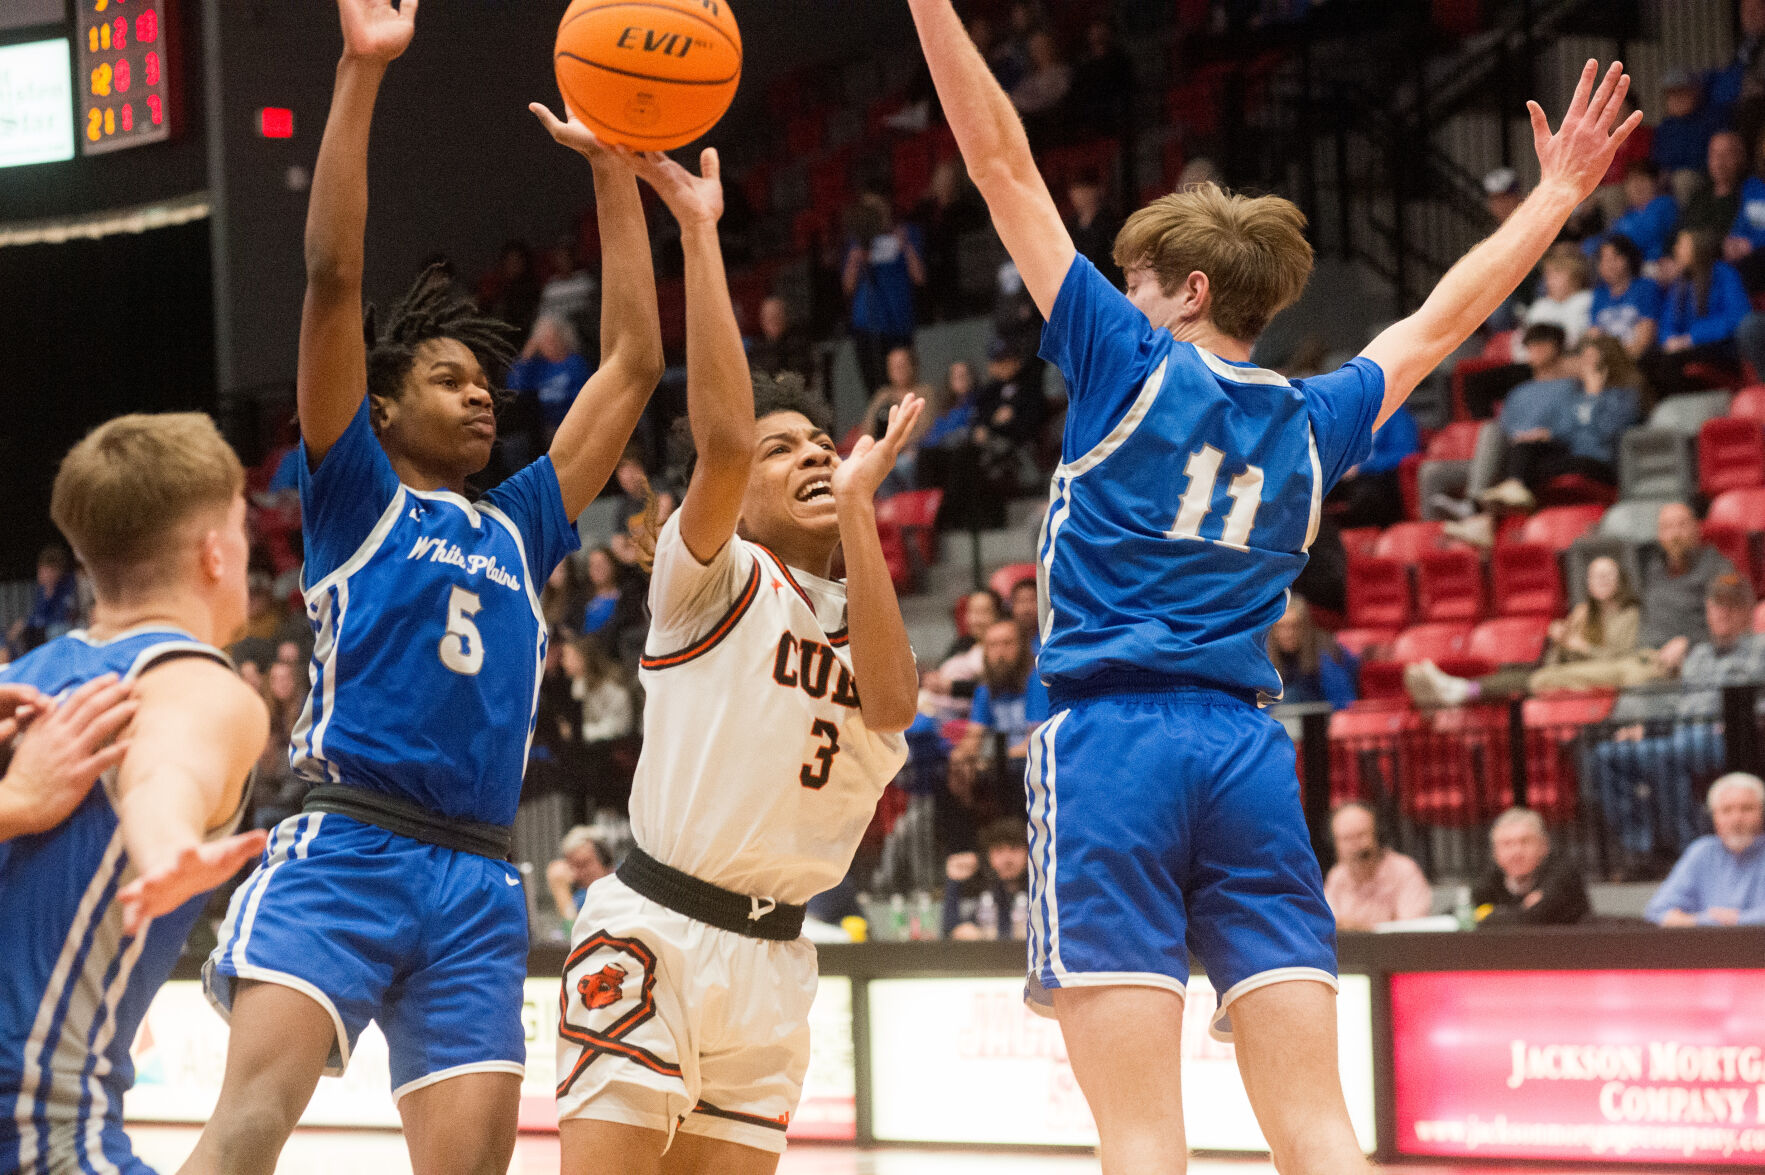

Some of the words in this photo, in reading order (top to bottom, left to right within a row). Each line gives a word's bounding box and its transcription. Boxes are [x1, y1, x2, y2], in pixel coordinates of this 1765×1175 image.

[88, 22, 111, 52] 11
[112, 16, 128, 50] 2
[616, 26, 693, 58] EVO
[145, 51, 160, 86] 3
[86, 107, 115, 141] 21
[1163, 441, 1265, 553] 11
[406, 536, 467, 570] White
[466, 554, 521, 592] Plains
[438, 583, 485, 677] 5
[799, 717, 841, 791] 3
[1507, 1039, 1642, 1088] JACKSON
[1649, 1041, 1765, 1082] MORTG
[1599, 1080, 1750, 1124] COMPANY
